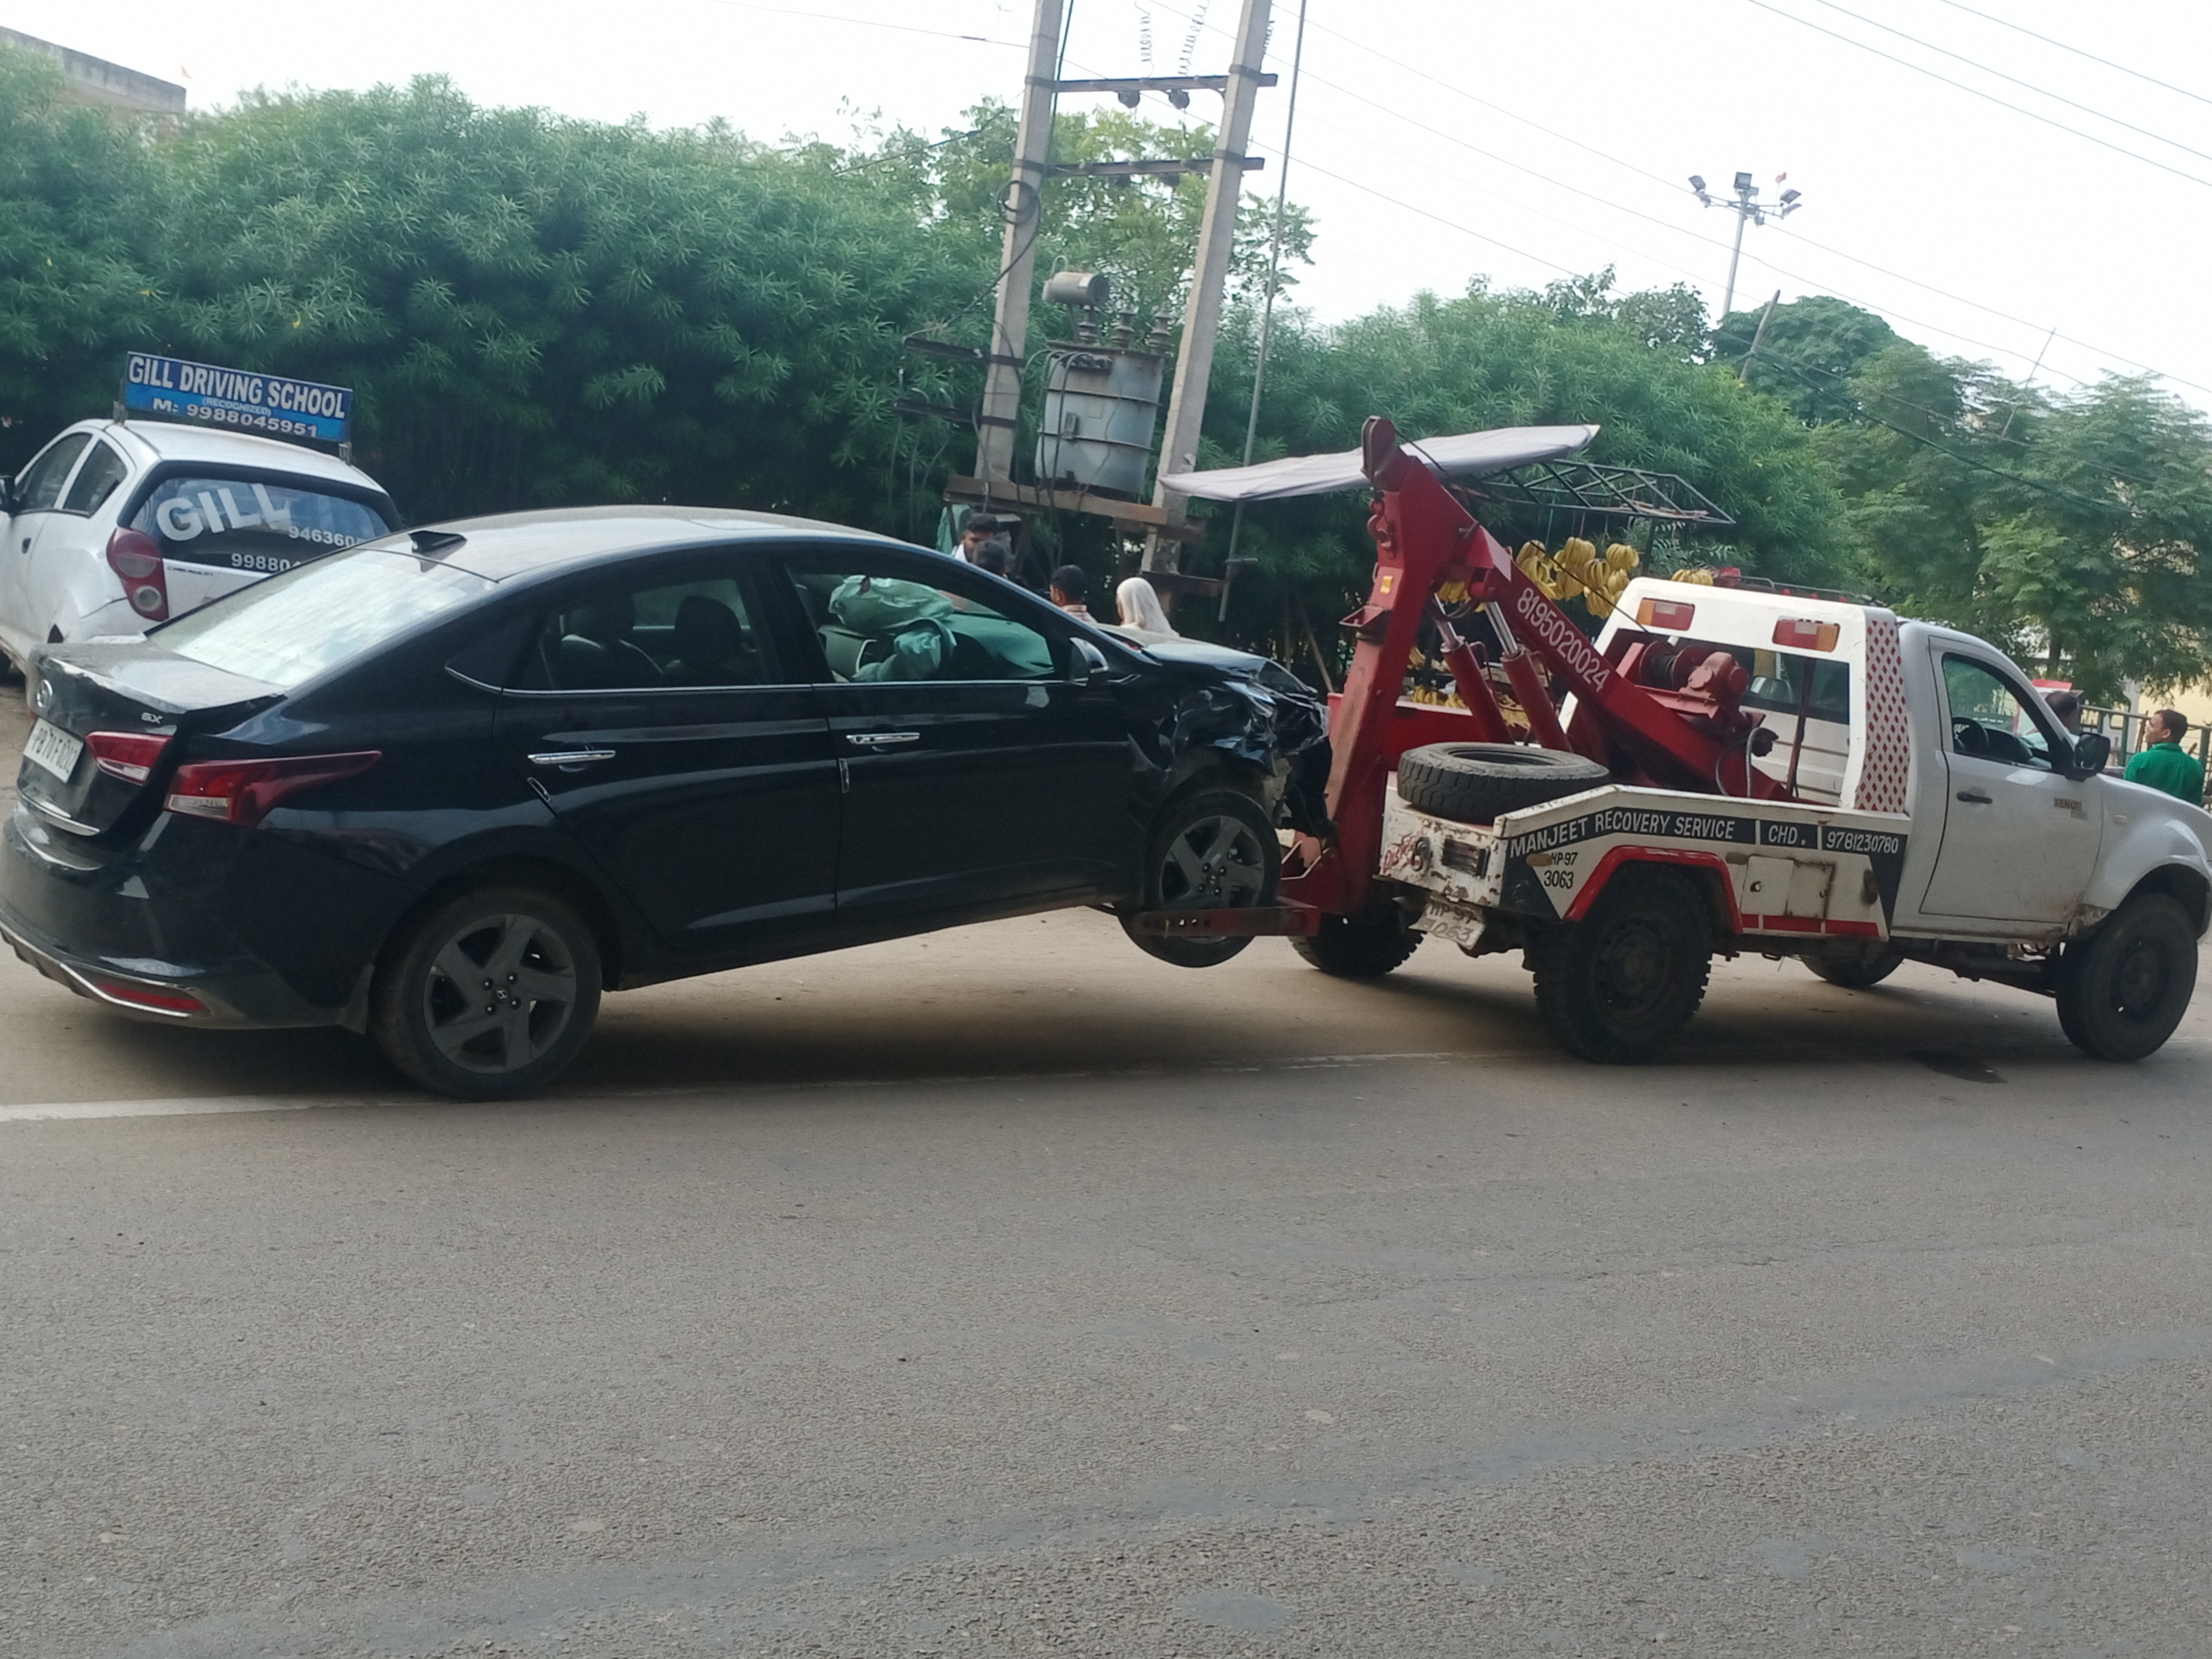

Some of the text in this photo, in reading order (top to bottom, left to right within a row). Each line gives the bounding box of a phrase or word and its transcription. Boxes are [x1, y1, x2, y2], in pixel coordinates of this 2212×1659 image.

[129, 356, 345, 419] GILL DRIVING SCHOOL
[187, 404, 317, 437] 9988045951
[156, 483, 291, 541] GILL
[1517, 588, 1610, 692] 8195020024
[141, 712, 163, 724] SX
[1510, 817, 1588, 858] MANJEET
[1595, 811, 1670, 834] RECOVERY
[1674, 817, 1735, 839] SERVICE
[1826, 831, 1899, 854] 9781230780
[1544, 870, 1574, 889] 3063
